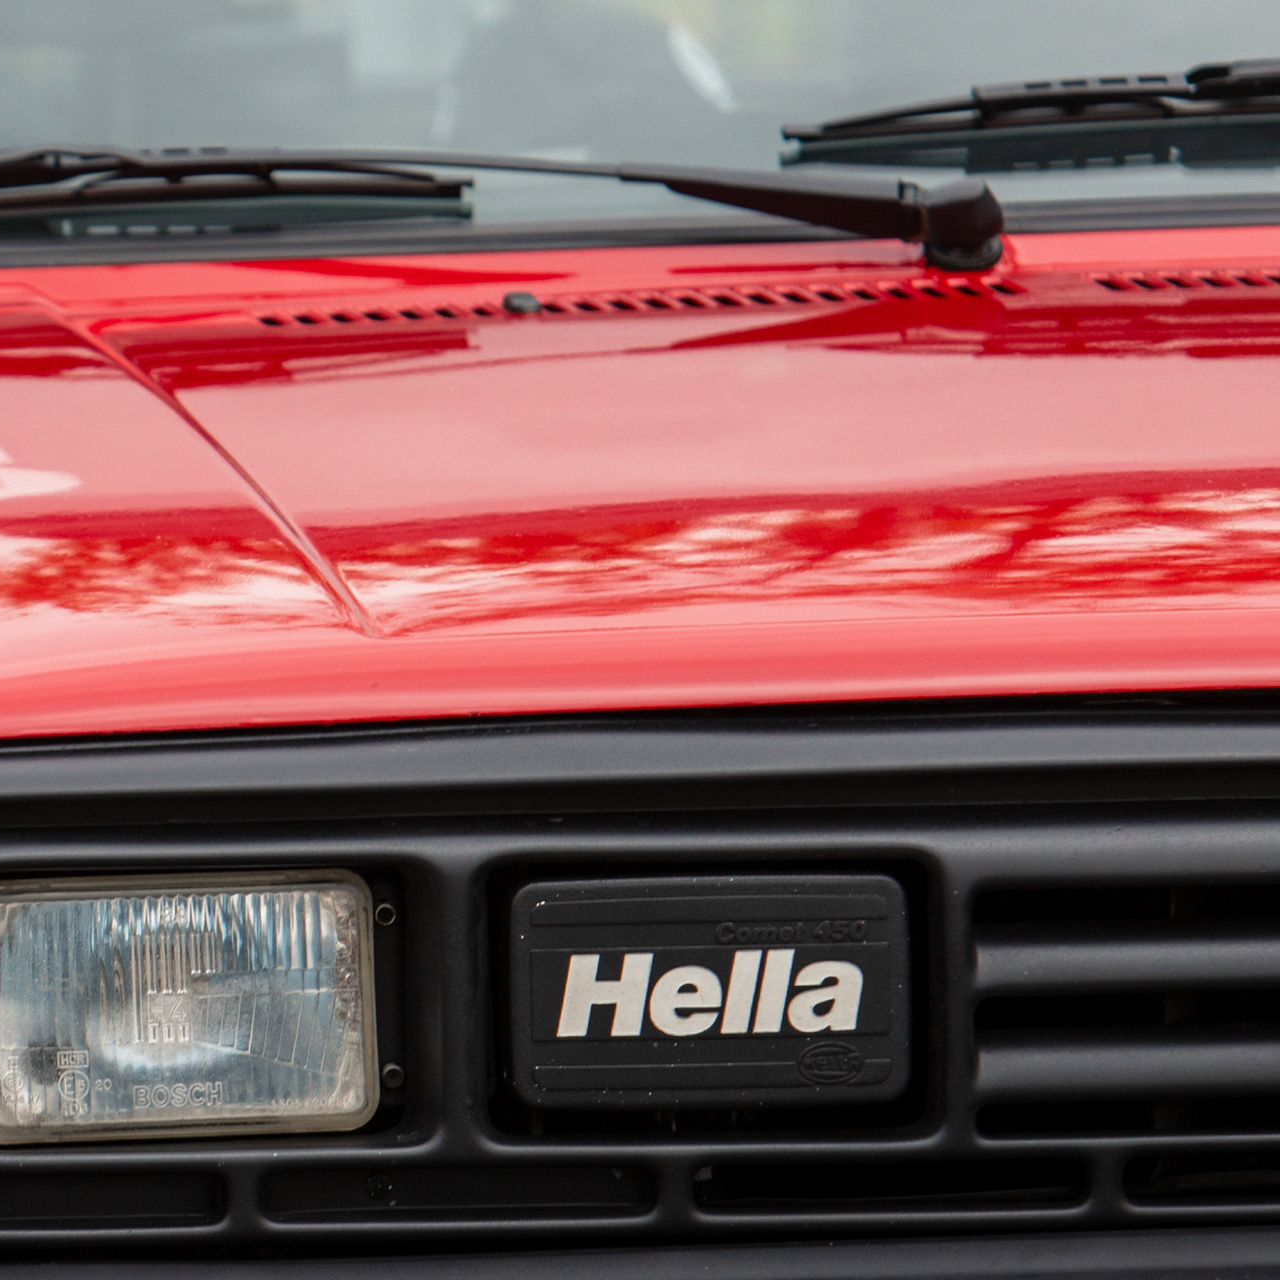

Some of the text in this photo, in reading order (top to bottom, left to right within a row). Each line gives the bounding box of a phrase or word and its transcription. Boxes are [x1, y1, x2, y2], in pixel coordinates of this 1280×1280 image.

[715, 920, 867, 944] Comet 450
[556, 948, 864, 1038] Hella
[132, 1081, 223, 1108] BOSCH
